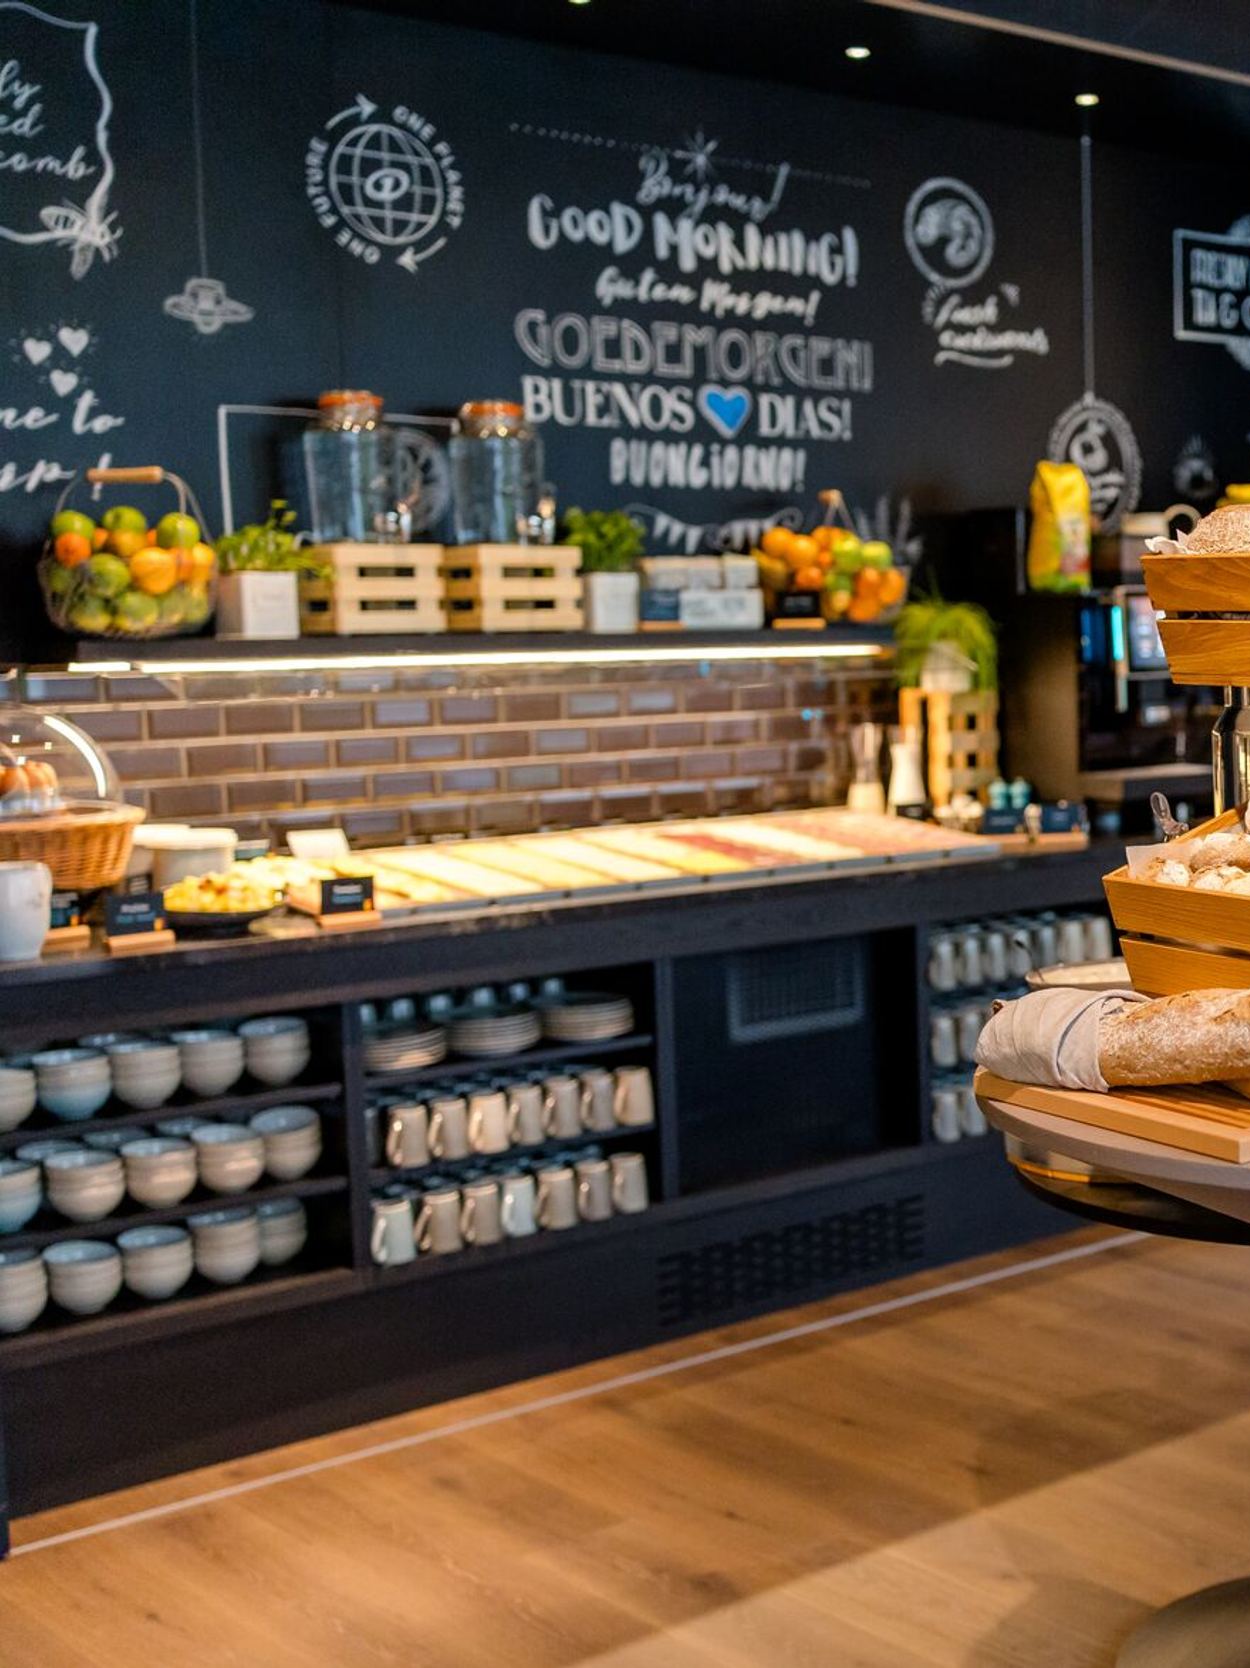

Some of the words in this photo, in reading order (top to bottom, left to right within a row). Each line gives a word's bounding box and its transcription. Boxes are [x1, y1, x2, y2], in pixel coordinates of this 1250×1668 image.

[305, 136, 340, 228] FUTURE
[392, 105, 437, 142] ONE
[432, 141, 465, 230] PLANET
[334, 226, 381, 265] ONE
[527, 193, 644, 255] GOOD
[652, 210, 860, 287] MORNING!
[72, 389, 125, 435] to
[521, 375, 697, 433] BUENOS
[758, 392, 853, 442] DIAS!
[610, 437, 807, 493] BUONGIORNO!
